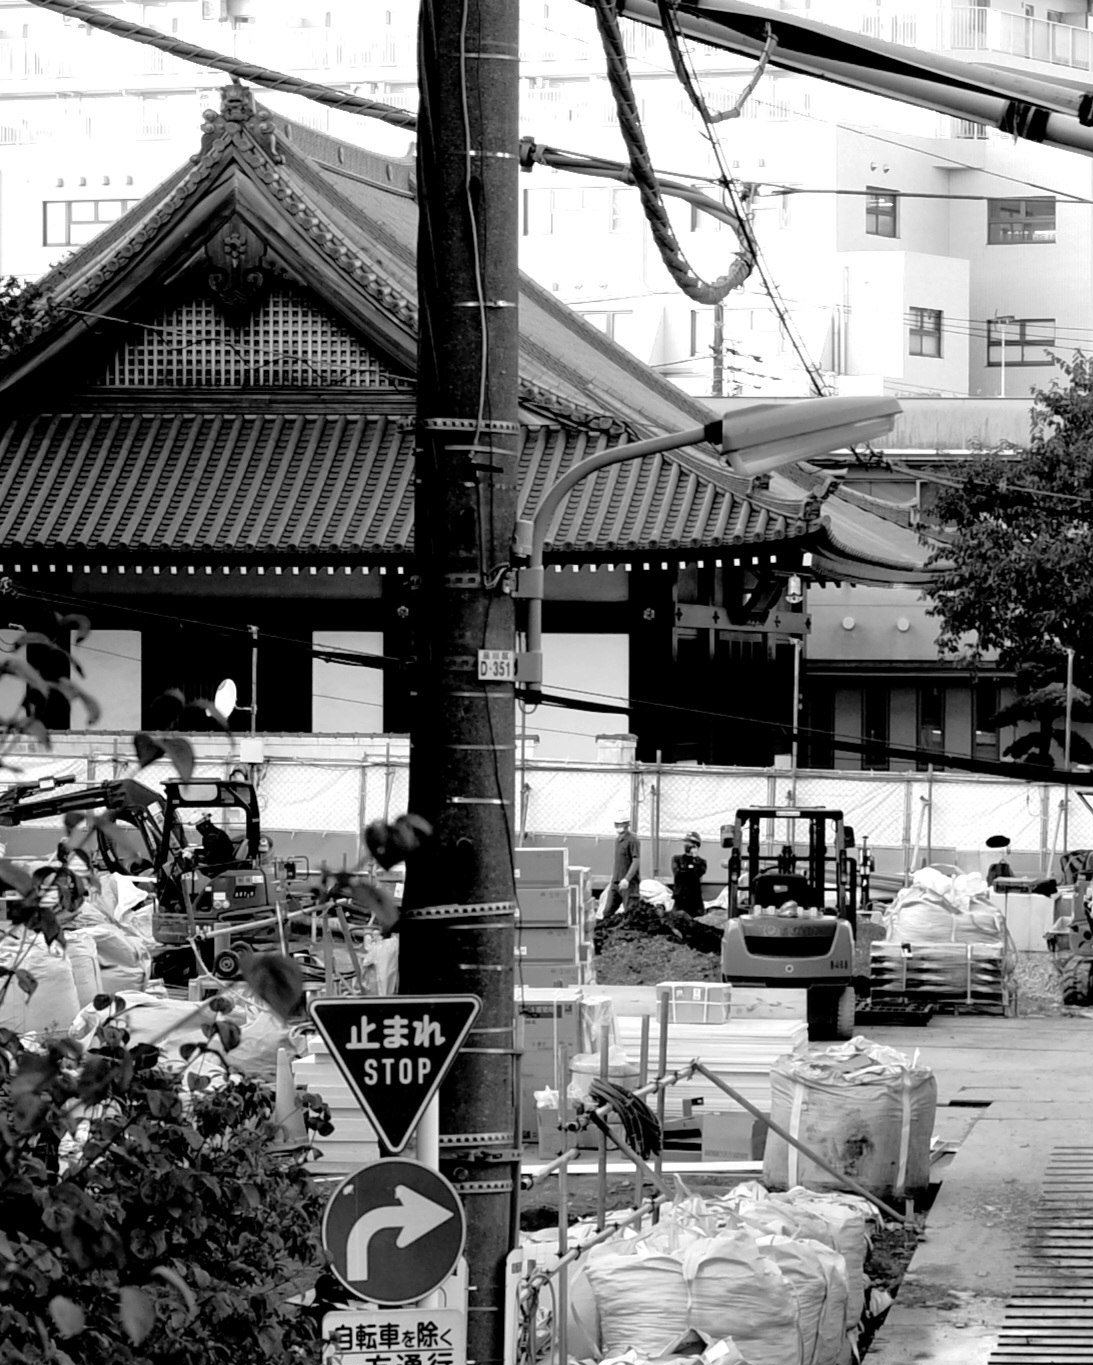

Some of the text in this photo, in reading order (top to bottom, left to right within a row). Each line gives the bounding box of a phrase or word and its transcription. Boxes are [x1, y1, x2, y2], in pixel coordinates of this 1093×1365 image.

[345, 1014, 446, 1050] 止まれ
[363, 1057, 432, 1086] STOP
[334, 1321, 453, 1350] 自転車を除く
